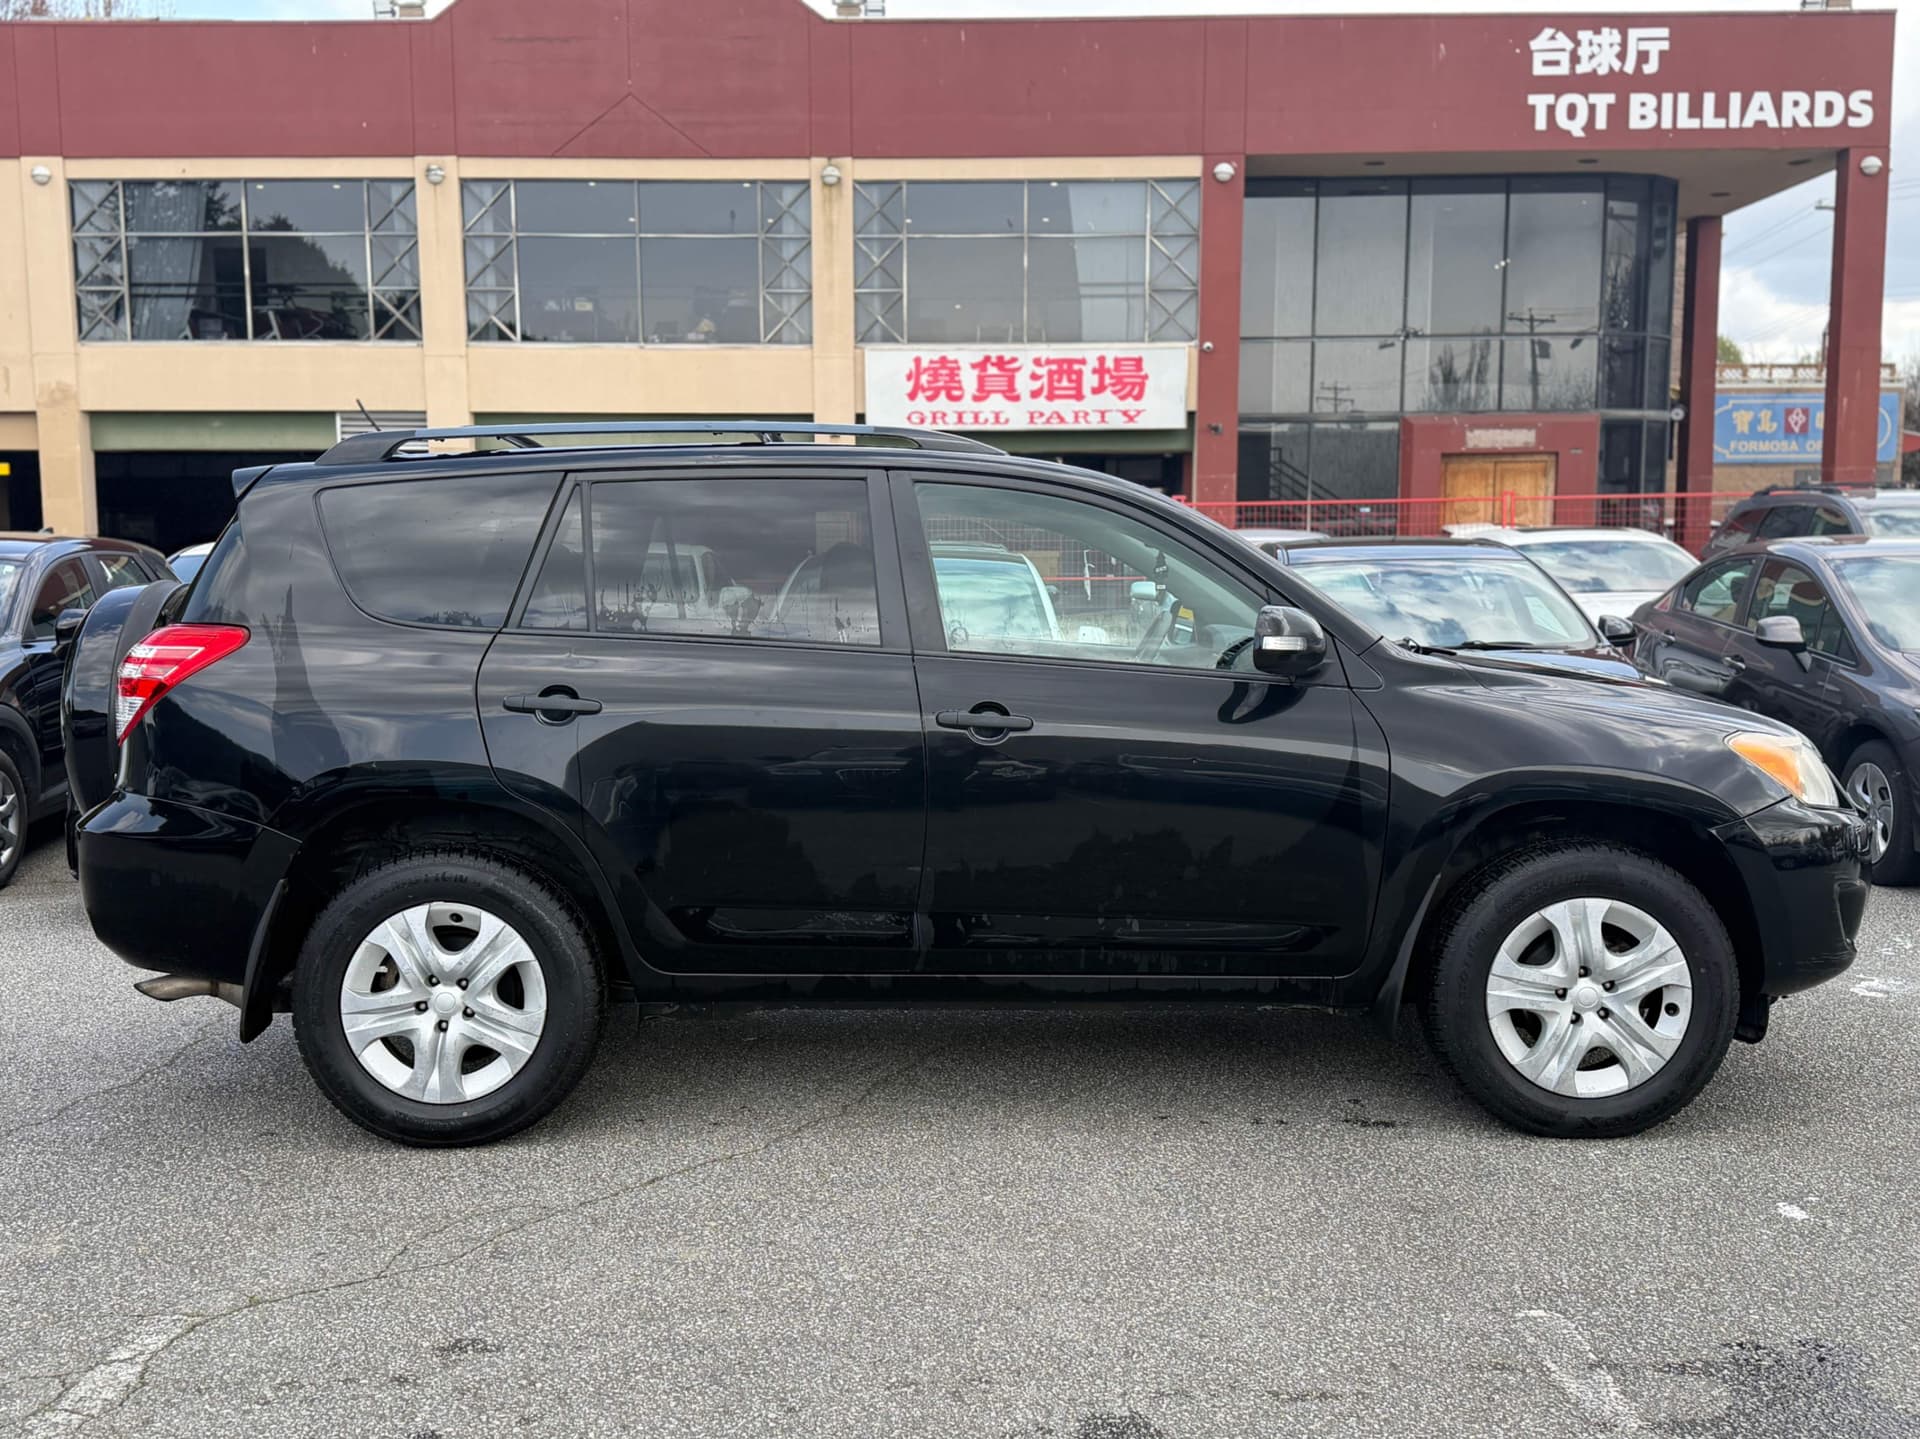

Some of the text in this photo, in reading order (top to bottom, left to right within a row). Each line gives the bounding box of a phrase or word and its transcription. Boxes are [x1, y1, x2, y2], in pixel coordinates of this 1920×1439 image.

[1529, 27, 1670, 76] 台球厅
[1527, 90, 1874, 137] TQT BILLIARDS
[905, 355, 1149, 403] 燒貨酒場
[906, 408, 1147, 426] GRILL PARTY
[1729, 440, 1799, 452] FORMOSA
